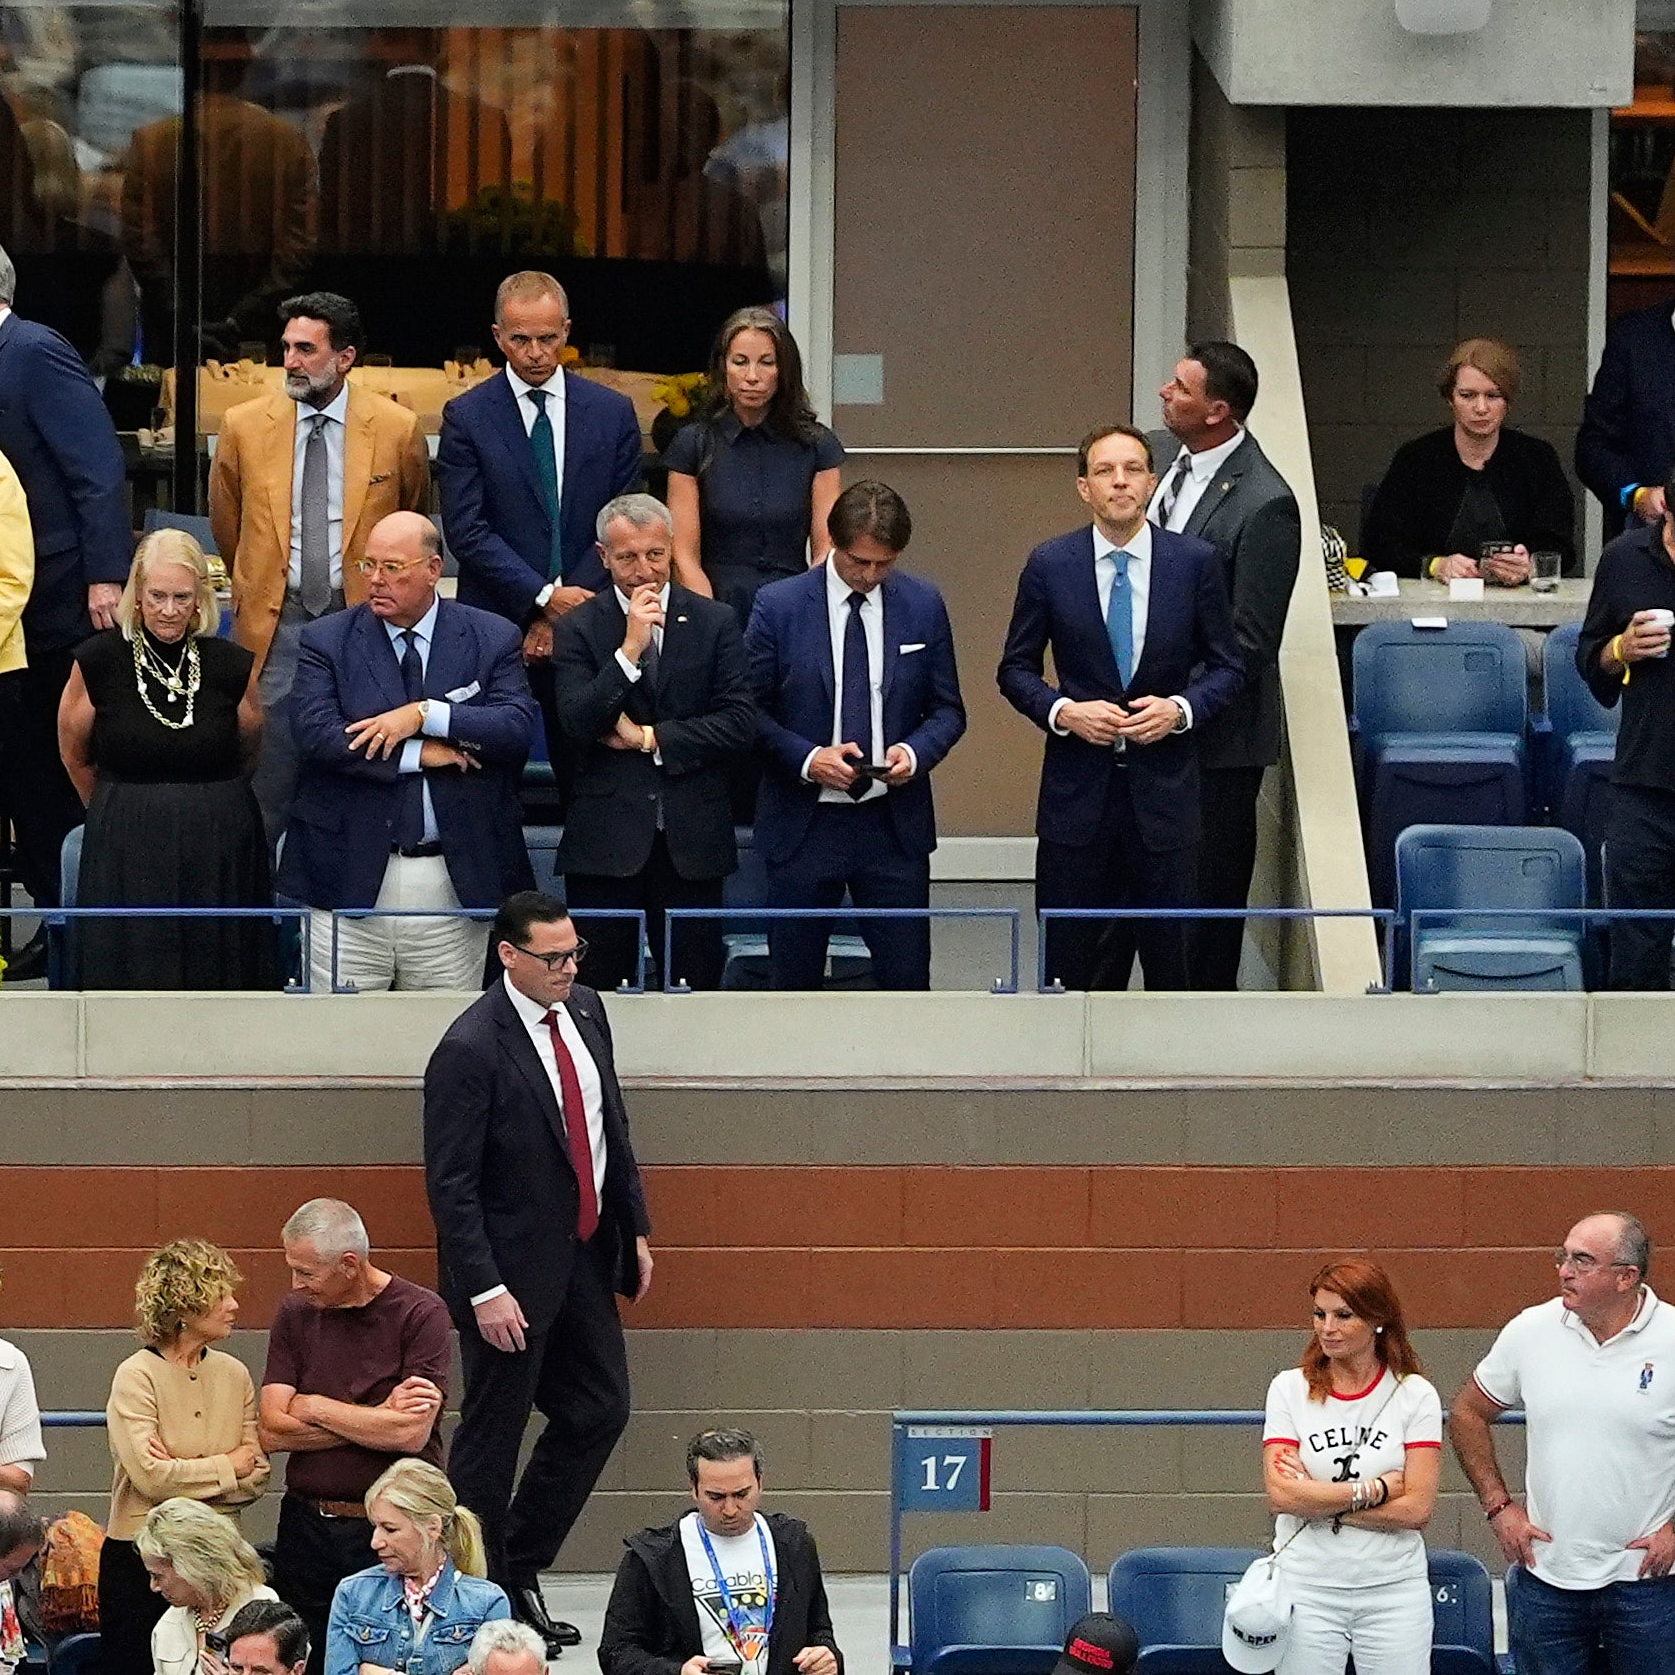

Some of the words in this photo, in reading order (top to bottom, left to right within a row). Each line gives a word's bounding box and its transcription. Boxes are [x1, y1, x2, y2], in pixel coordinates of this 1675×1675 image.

[911, 1427, 992, 1438] SECTION
[921, 1455, 968, 1491] 17
[1436, 1586, 1448, 1603] 6
